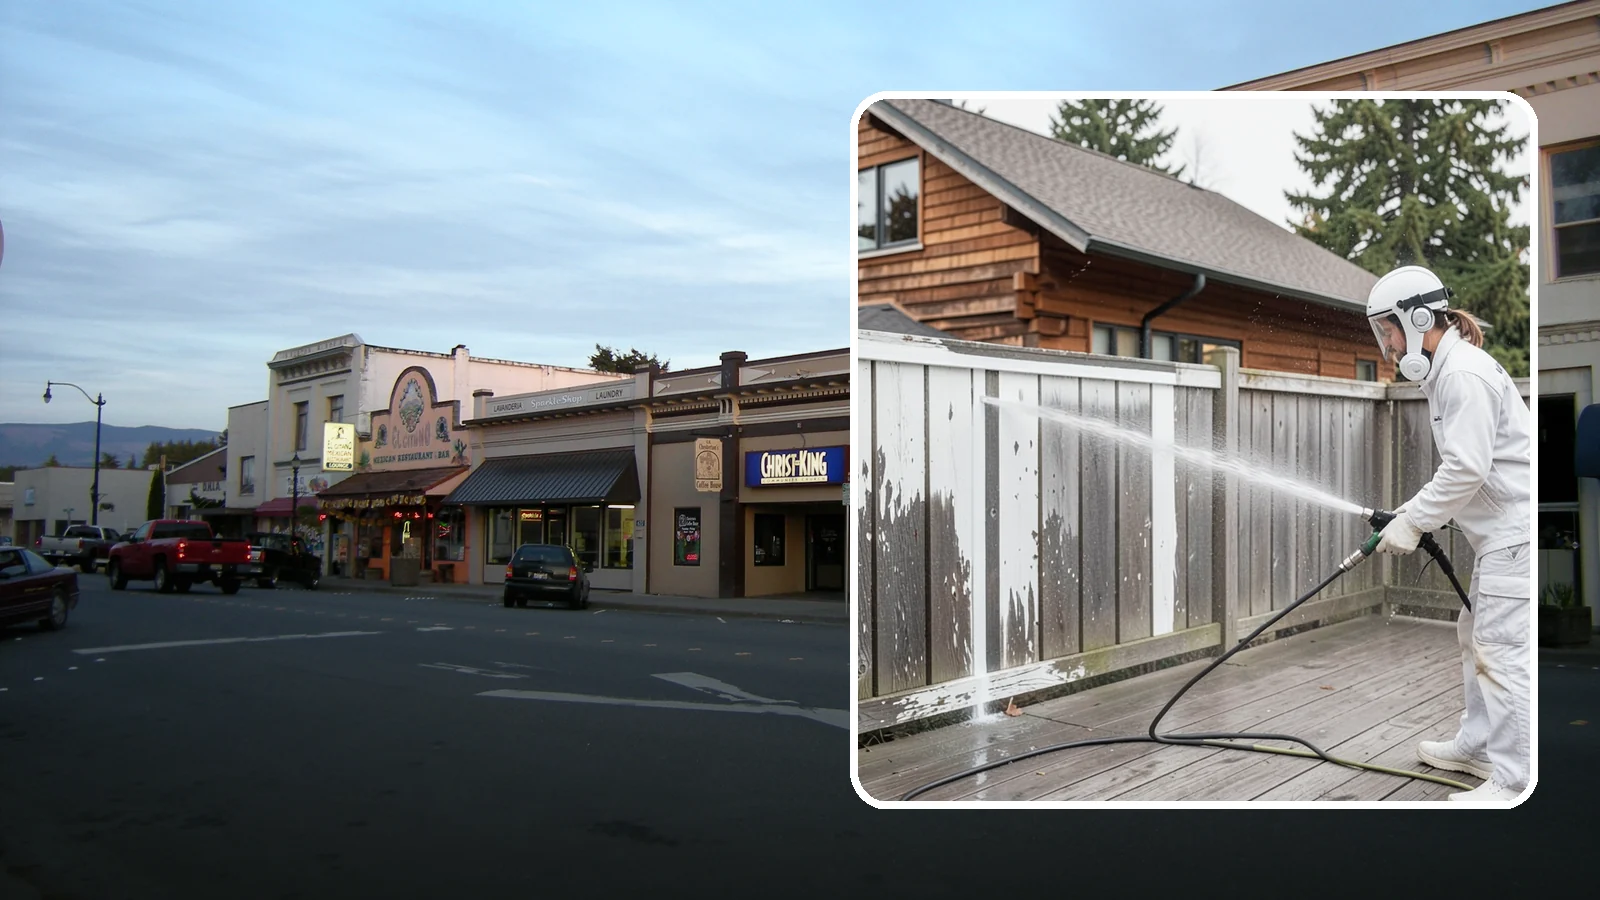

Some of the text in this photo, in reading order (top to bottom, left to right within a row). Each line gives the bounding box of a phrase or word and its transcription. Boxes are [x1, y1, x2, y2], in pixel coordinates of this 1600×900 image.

[595, 389, 624, 400] LAUNDRY
[493, 402, 523, 413] LAVANDERIA
[530, 395, 582, 409] Sparkle Shop
[373, 455, 396, 463] MEXICAN
[397, 451, 433, 462] RESTAURANT
[438, 450, 450, 459] BAR
[761, 452, 797, 478] CHRIST
[798, 450, 827, 476] KING
